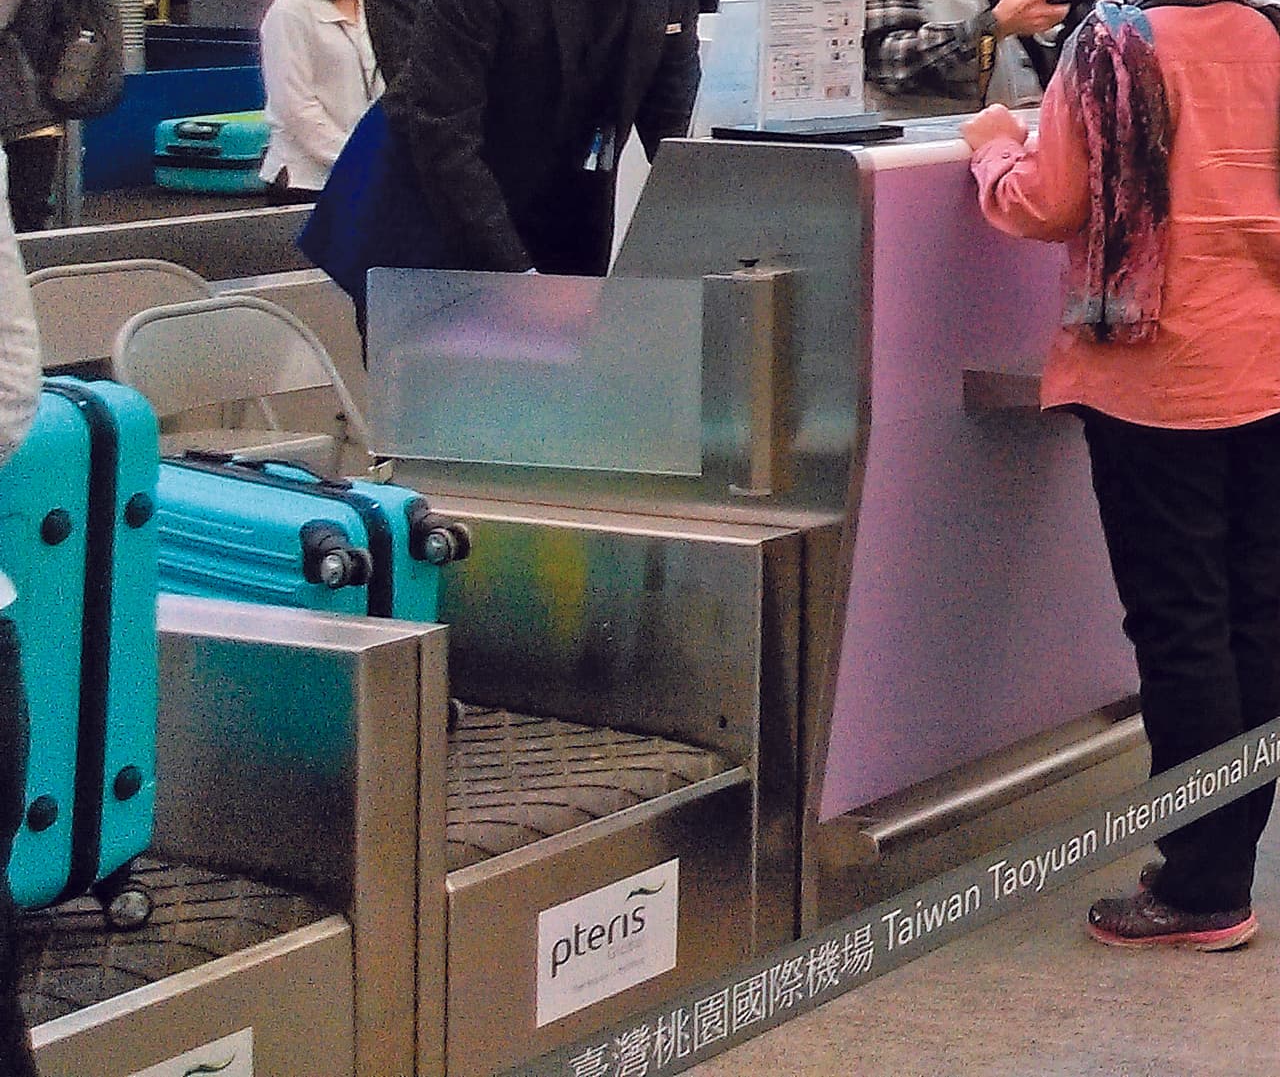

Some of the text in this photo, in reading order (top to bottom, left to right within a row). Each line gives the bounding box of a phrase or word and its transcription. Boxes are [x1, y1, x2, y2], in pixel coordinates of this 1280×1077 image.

[881, 882, 980, 952] Taiwan
[986, 829, 1097, 901] Taoyuan
[1103, 744, 1248, 846] International
[551, 905, 645, 978] pteris
